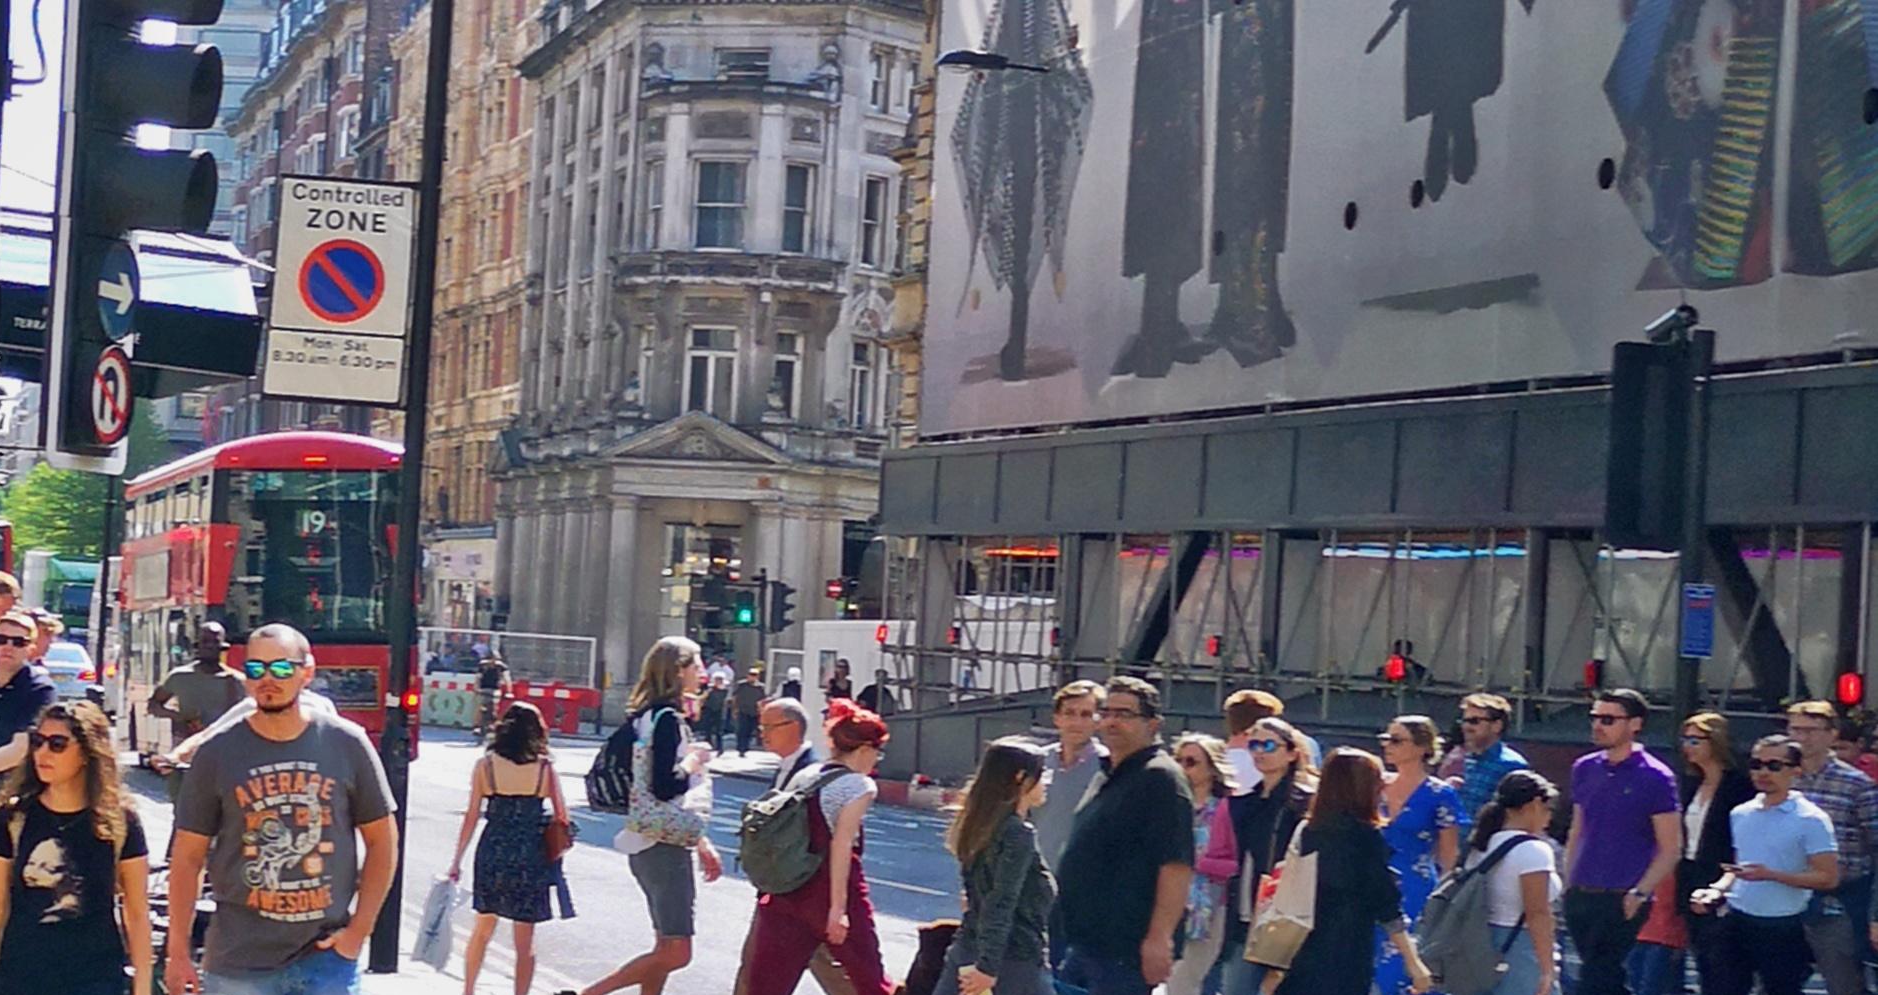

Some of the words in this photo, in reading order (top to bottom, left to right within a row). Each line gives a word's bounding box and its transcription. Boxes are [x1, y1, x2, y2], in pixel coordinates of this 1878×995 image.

[292, 183, 404, 207] Controlled
[306, 209, 387, 233] ZONE
[344, 340, 369, 352] Sat
[301, 510, 326, 534] 19
[247, 884, 334, 913] AWESOME
